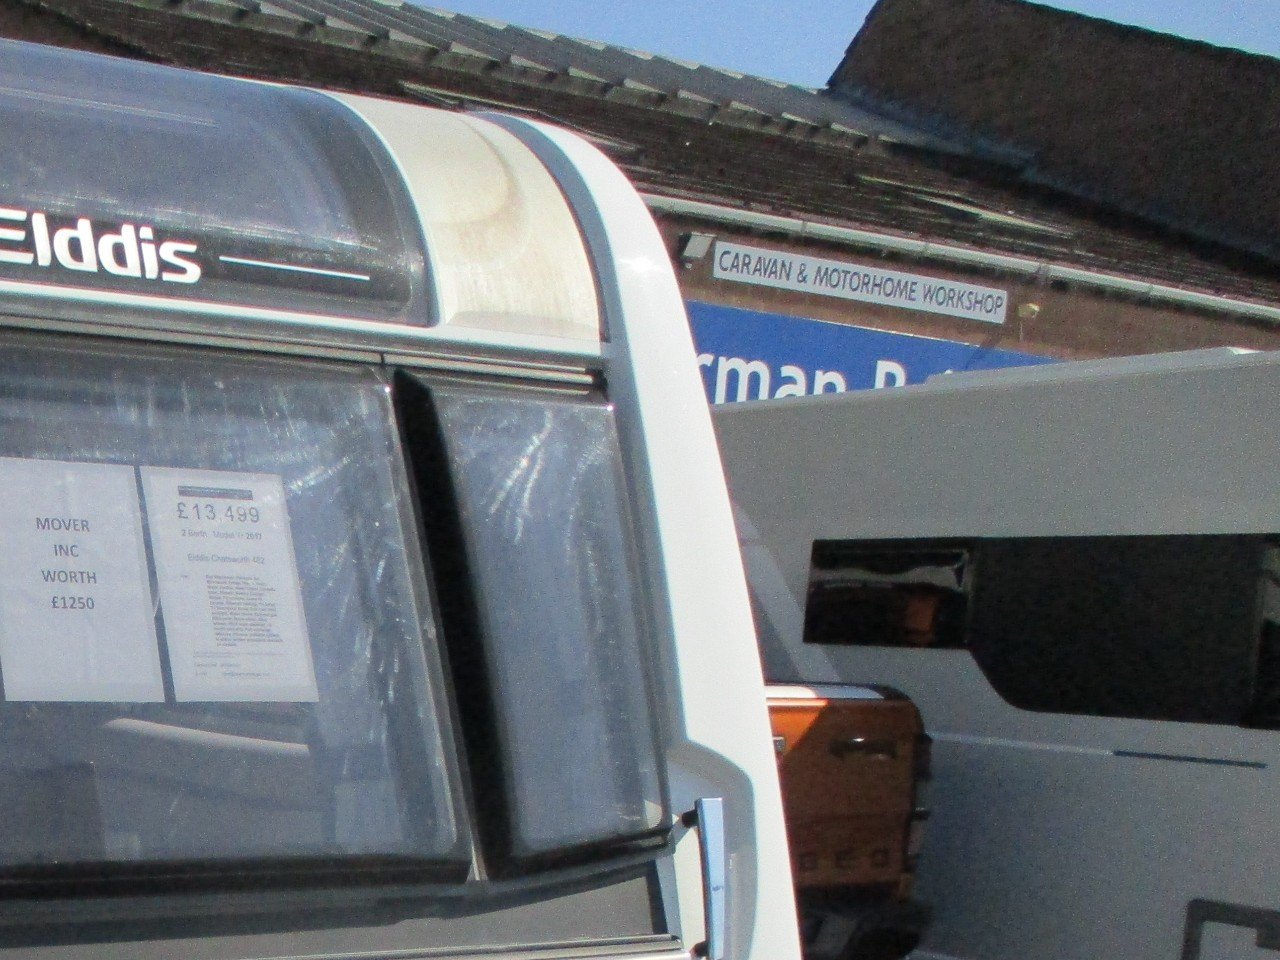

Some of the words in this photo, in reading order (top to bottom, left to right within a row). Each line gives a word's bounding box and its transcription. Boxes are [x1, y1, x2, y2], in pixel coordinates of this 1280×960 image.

[719, 249, 793, 282] CARAVAN
[796, 262, 808, 284] &
[813, 265, 918, 302] MOTORHOME
[922, 282, 1004, 315] WORKSHOP
[35, 517, 90, 532] MOVER
[53, 544, 79, 558] INC
[41, 569, 98, 584] WORTH
[51, 596, 96, 610] £1250
